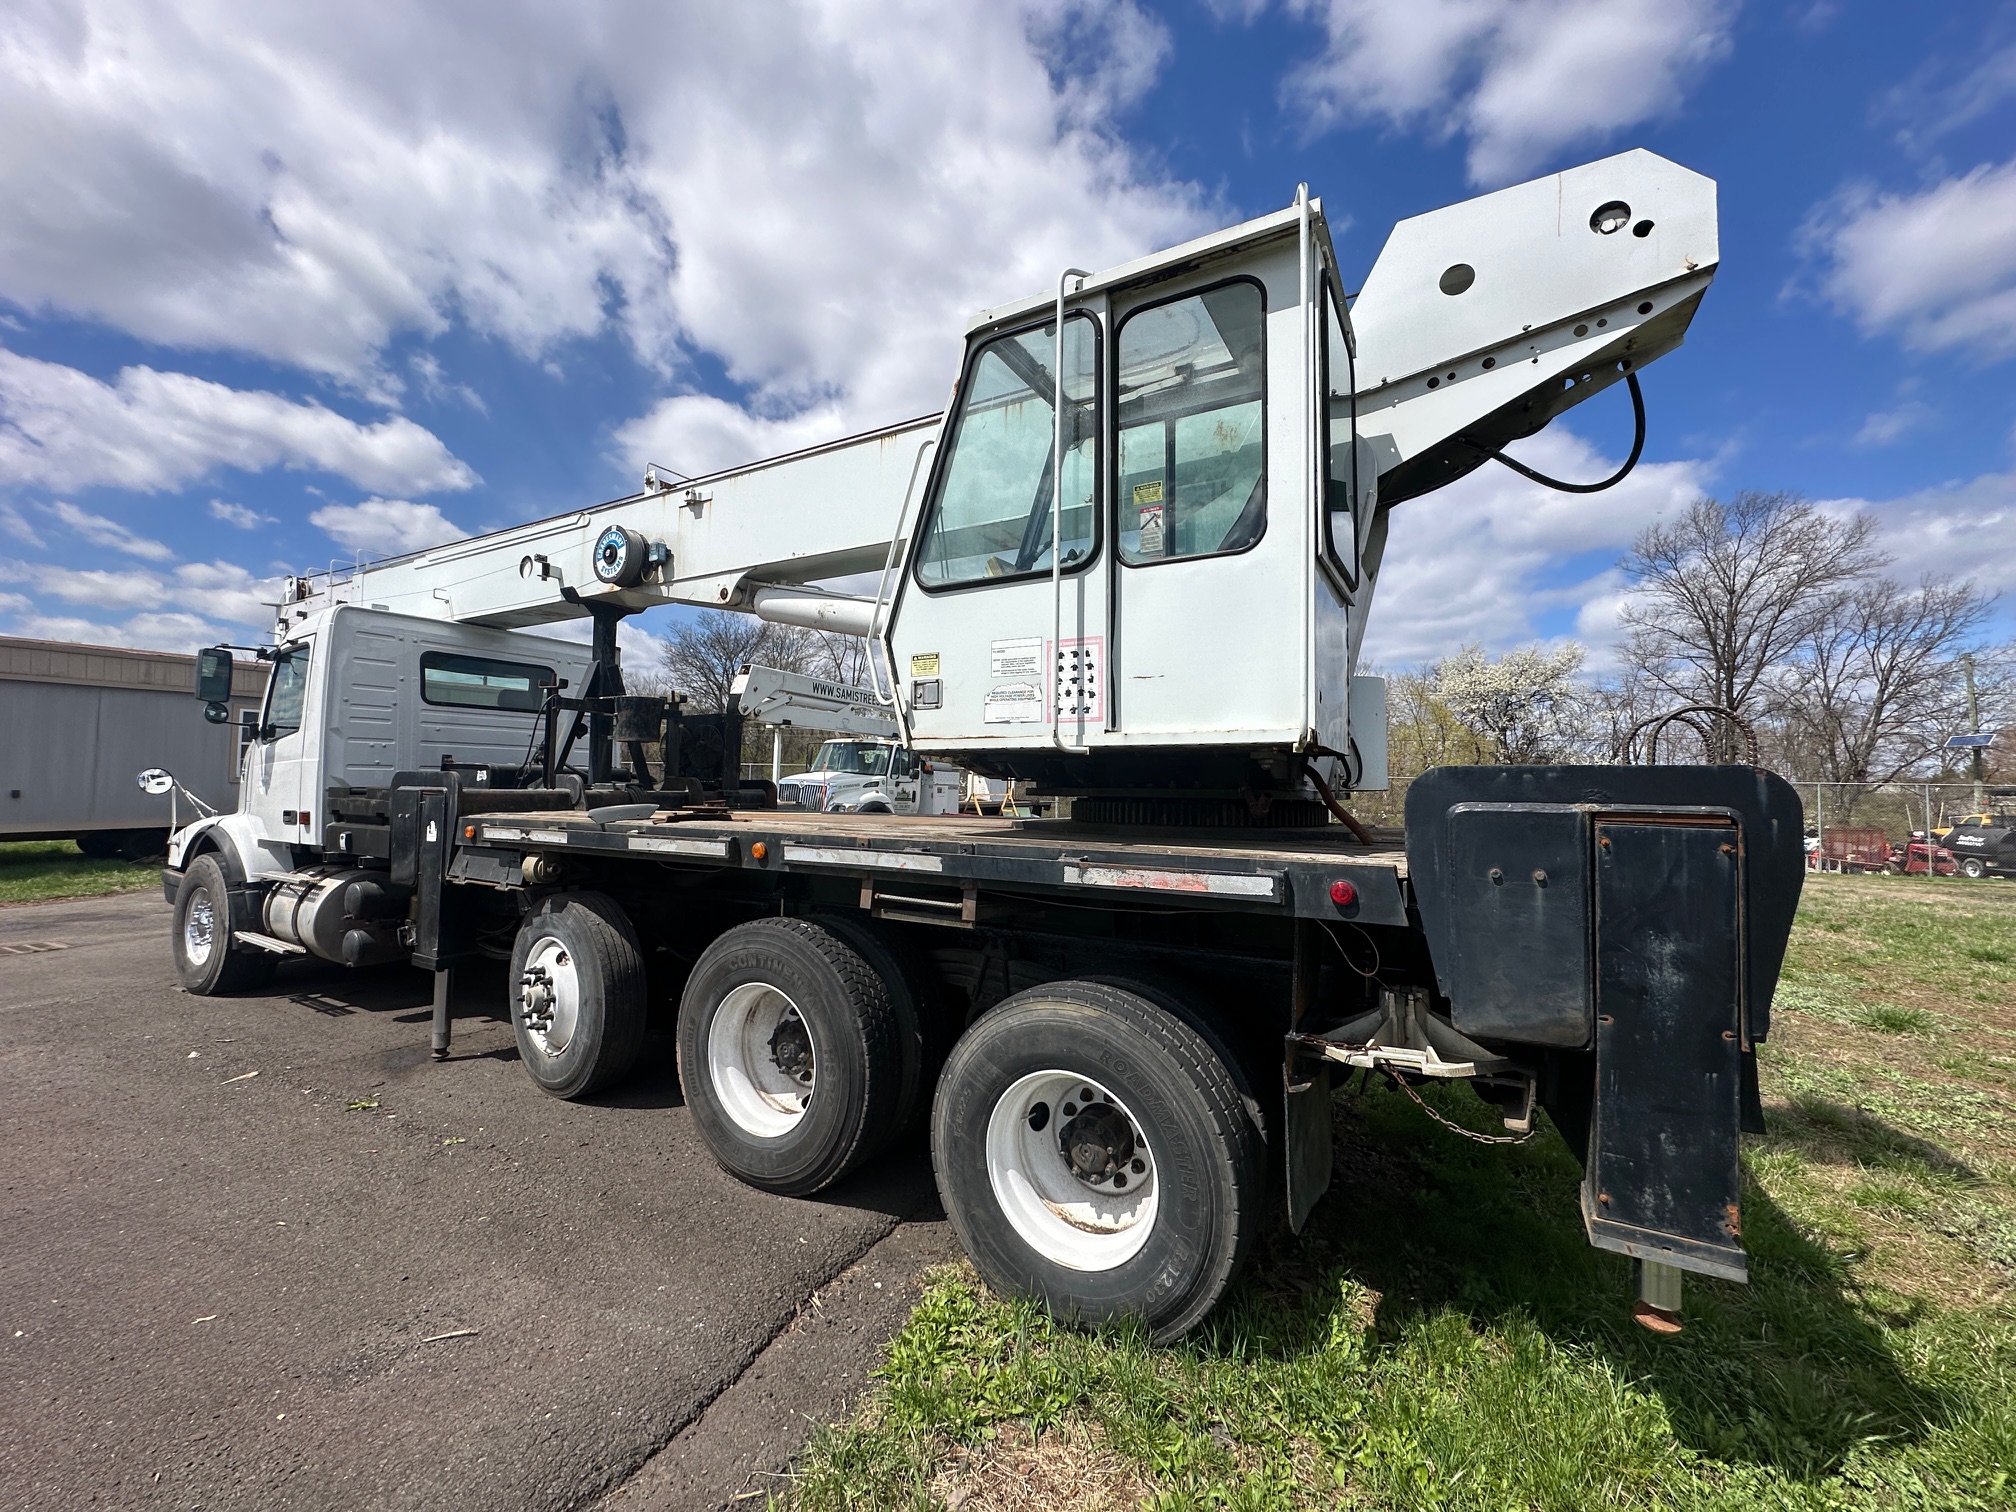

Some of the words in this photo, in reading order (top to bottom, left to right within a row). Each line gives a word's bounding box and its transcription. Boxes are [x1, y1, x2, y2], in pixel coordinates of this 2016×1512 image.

[597, 533, 624, 559] CRANESMART
[601, 556, 623, 575] SYSTEMS
[1098, 1048, 1199, 1204] ROADMASTER
